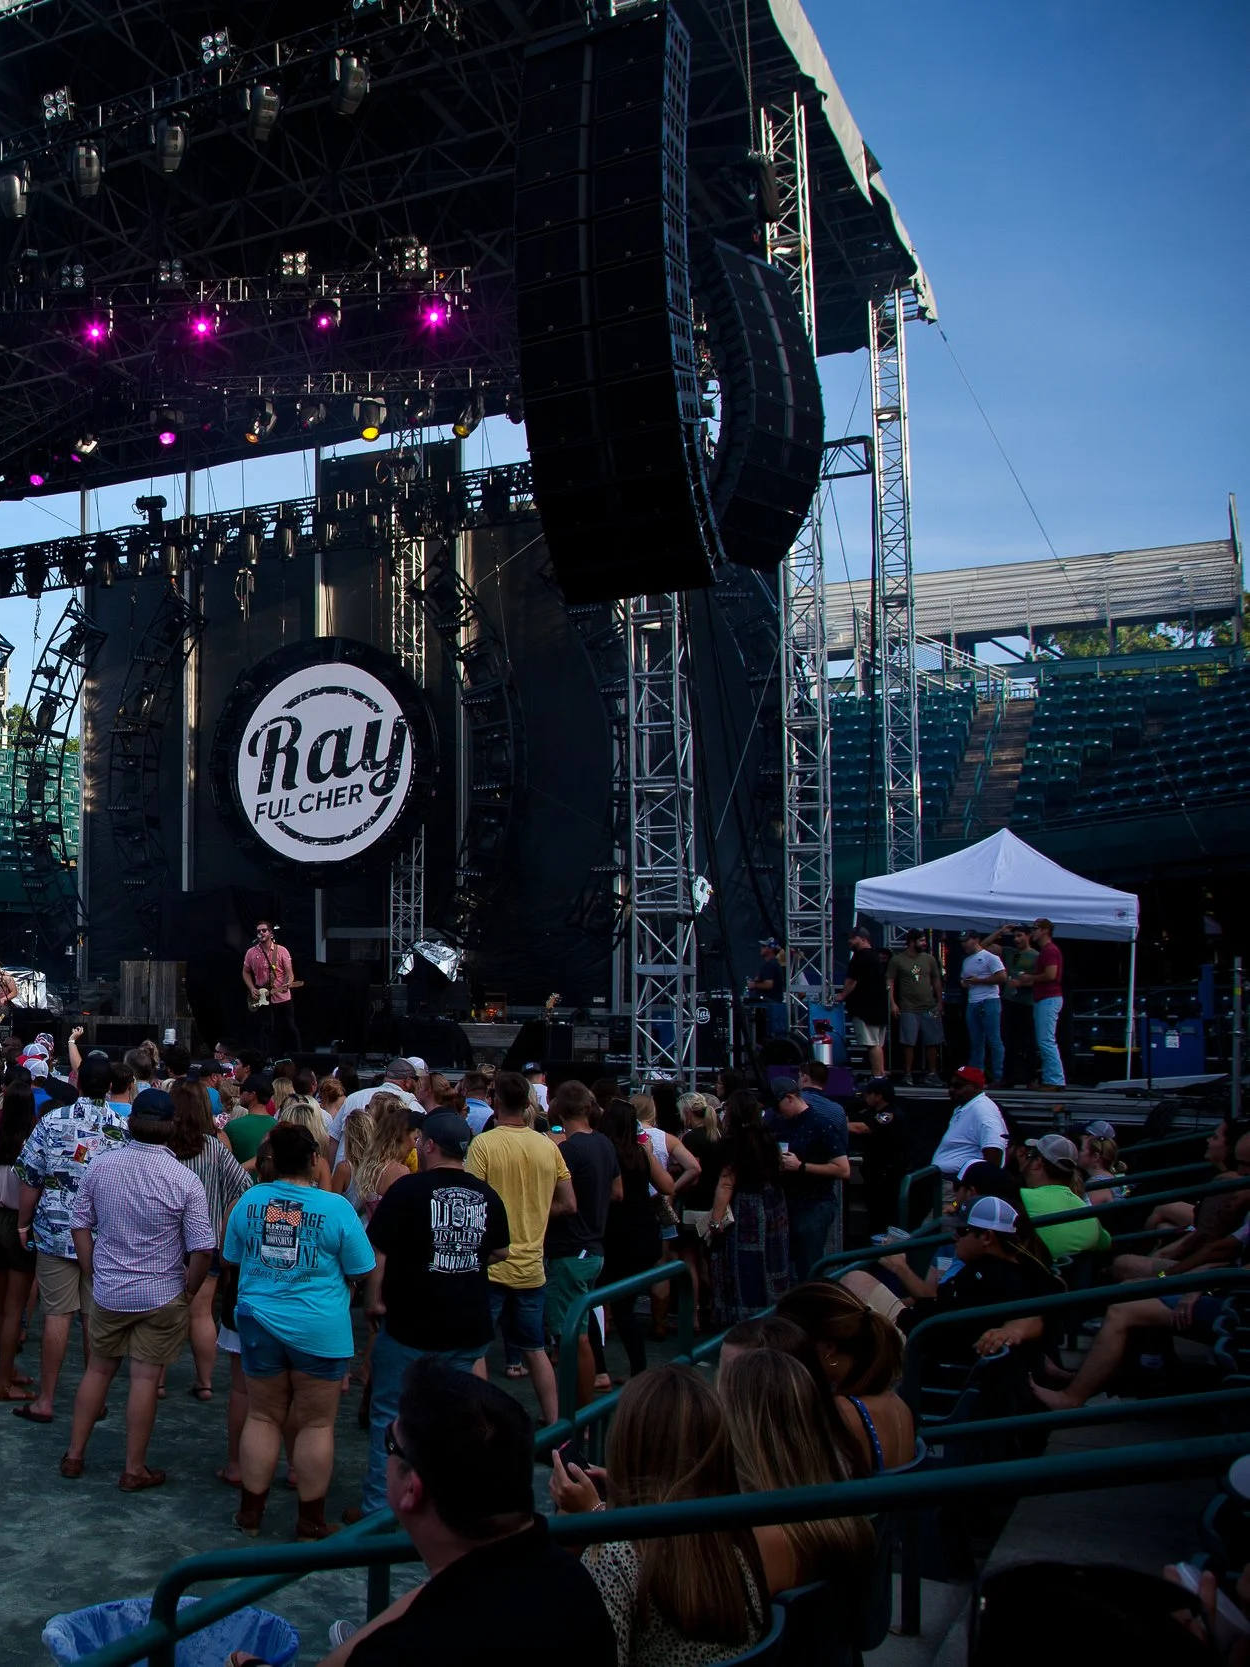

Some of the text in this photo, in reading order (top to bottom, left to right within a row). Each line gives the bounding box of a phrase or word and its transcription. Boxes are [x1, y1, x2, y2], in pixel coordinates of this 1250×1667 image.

[247, 714, 409, 797] Ray
[254, 783, 364, 825] FULCHER
[431, 1199, 488, 1231] OLD FORGE
[433, 1231, 483, 1243] DISTILLERY
[434, 1252, 479, 1270] MOONSHINE
